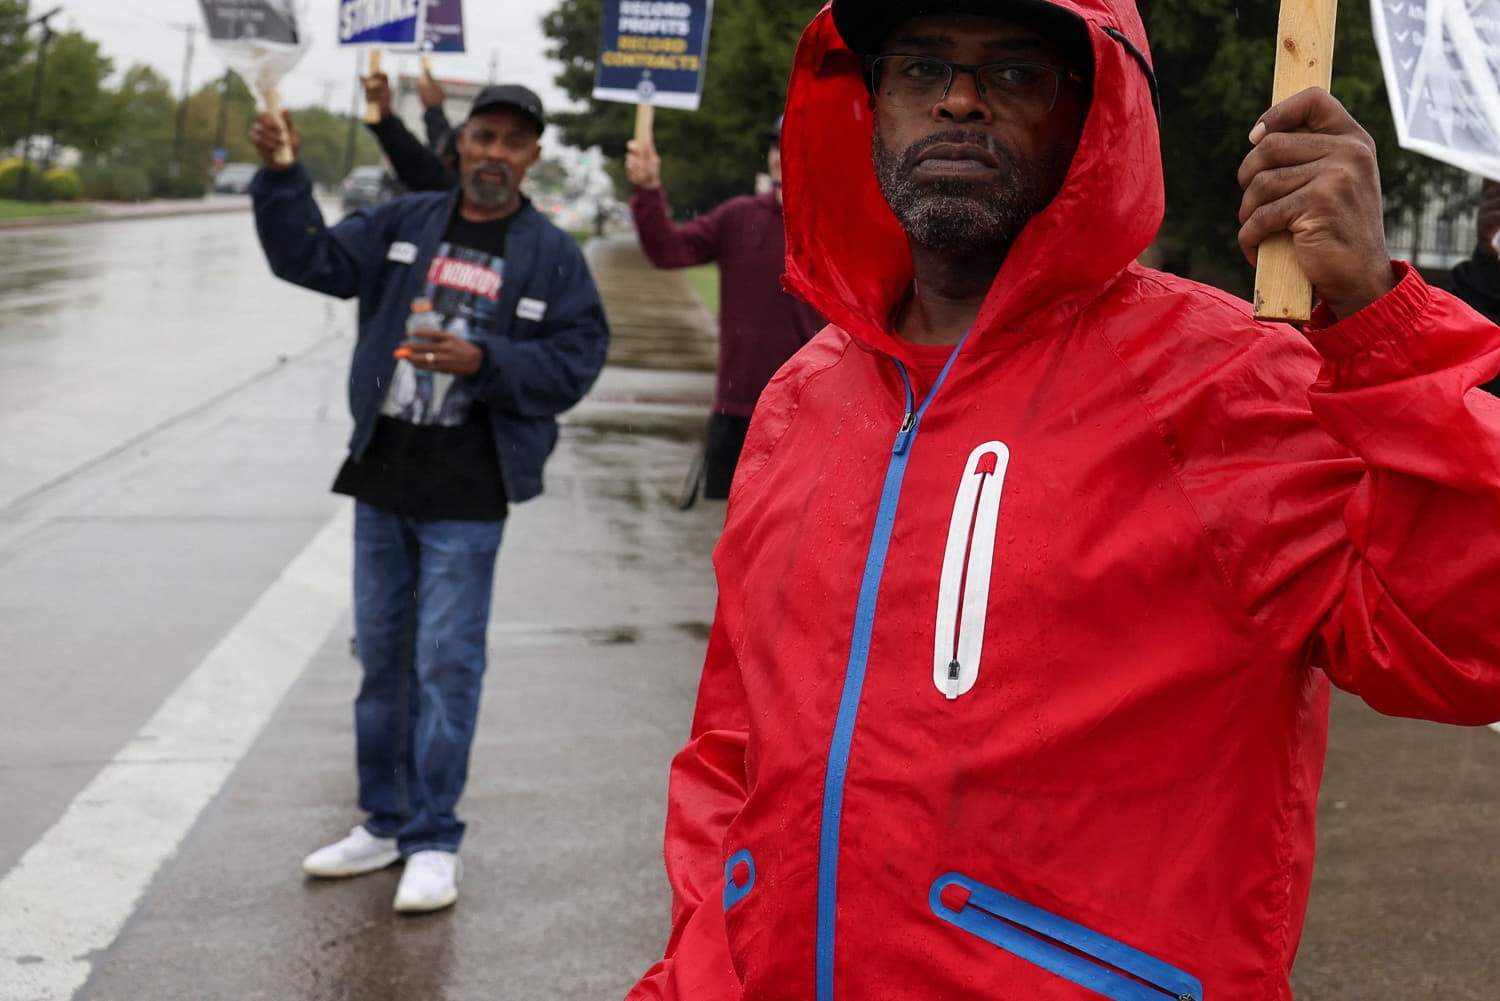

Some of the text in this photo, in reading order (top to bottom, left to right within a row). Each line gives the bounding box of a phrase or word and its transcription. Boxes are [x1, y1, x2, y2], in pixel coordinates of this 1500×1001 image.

[619, 0, 692, 19] RECORD
[618, 16, 691, 36] PROFITS
[617, 35, 688, 54] RECORD
[602, 50, 699, 72] CONTRACTS
